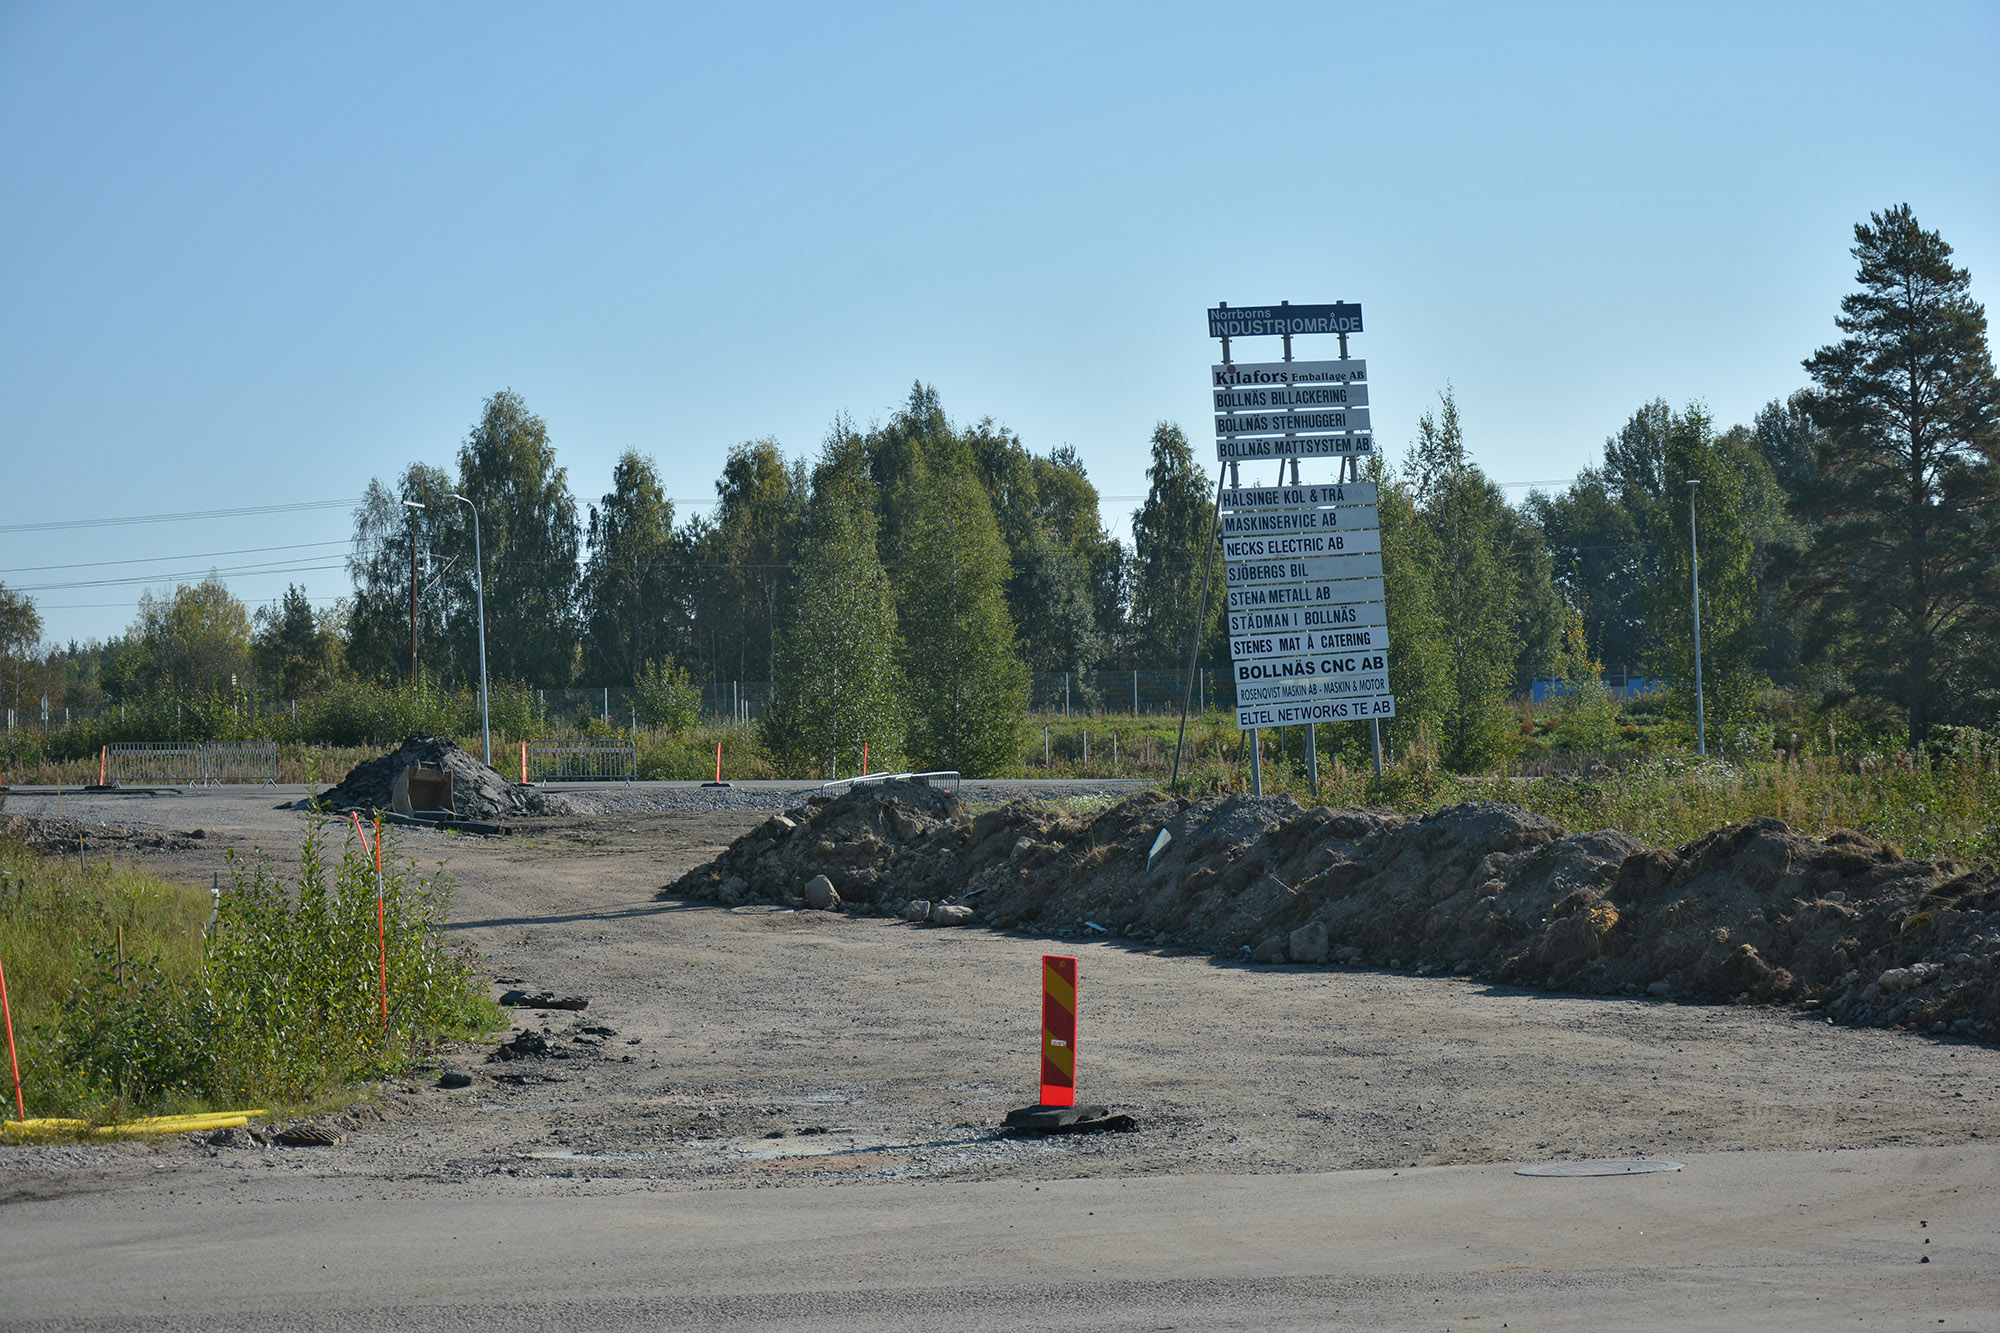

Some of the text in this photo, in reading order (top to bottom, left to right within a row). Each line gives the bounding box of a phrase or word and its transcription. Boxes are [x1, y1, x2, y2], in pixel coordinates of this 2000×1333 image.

[1211, 309, 1271, 320] Norrborns
[1212, 312, 1360, 335] INDUSTRIOMRÅDE
[1216, 370, 1364, 384] Kilafors Emballage AB
[1217, 389, 1347, 407] BOLLNÄS BILLACKERING
[1218, 413, 1346, 433] BOLLNÄS STENHUGGERI
[1220, 438, 1369, 457] BOLLNÄS MATTSYSTEM AB
[1223, 486, 1344, 507] HÄLSINGE KOL & TRÄ
[1225, 513, 1336, 531] MASKINSERVICE AB
[1227, 537, 1343, 556] NECKS ELECTRIC AB
[1229, 564, 1308, 581] SJÖBERGS BIL
[1231, 586, 1330, 606] STENA METALL AB
[1232, 606, 1356, 630] STÄDMAN I BOLLNÄS
[1234, 632, 1370, 654] STENES MAT Å CATERING
[1239, 657, 1384, 679] BOLLNÄS CNC AB
[1241, 687, 1280, 701] ROSENQVIST
[1282, 685, 1307, 697] MASKIN
[1308, 685, 1317, 694] AB
[1324, 681, 1350, 694] MASKIN
[1353, 681, 1358, 690] &
[1359, 678, 1385, 690] MOTOR
[1241, 701, 1390, 725] ELTEL NETWORKS TE AB
